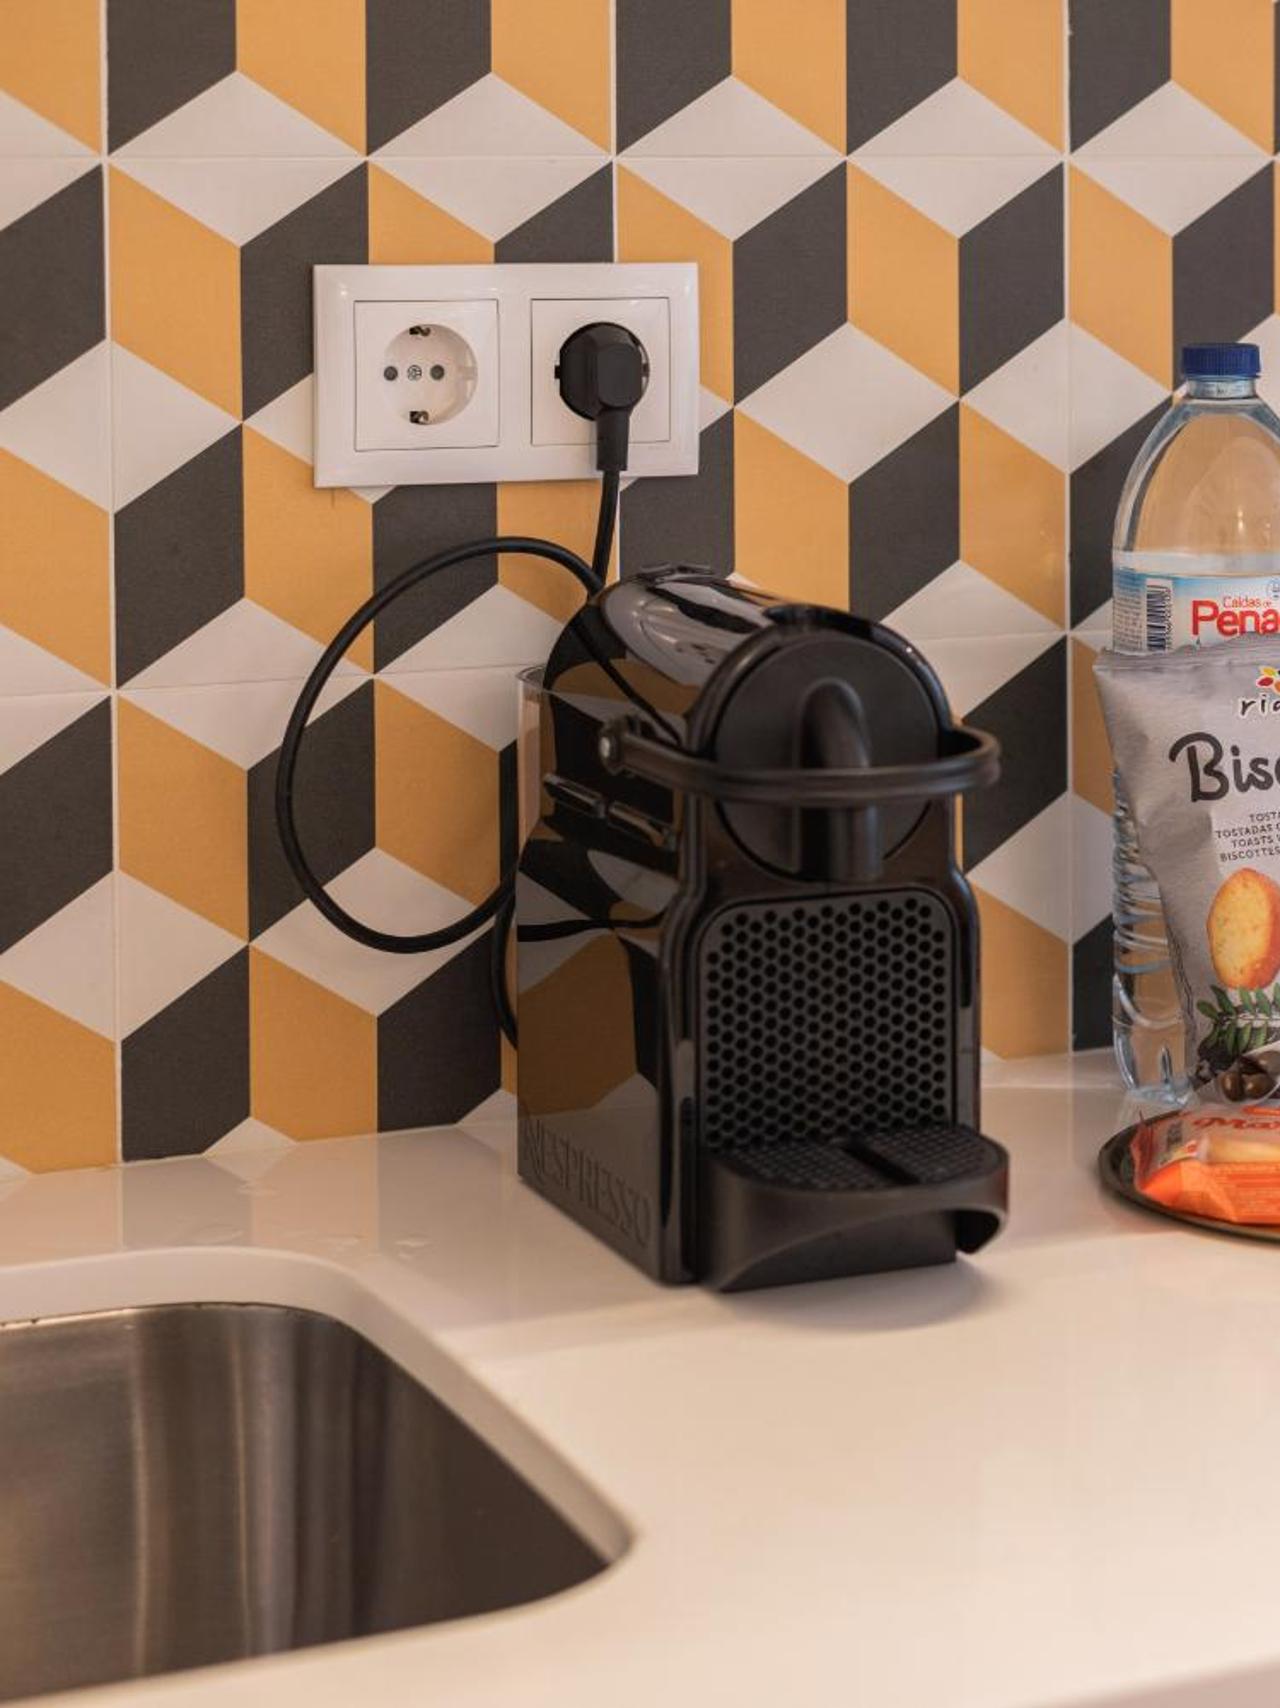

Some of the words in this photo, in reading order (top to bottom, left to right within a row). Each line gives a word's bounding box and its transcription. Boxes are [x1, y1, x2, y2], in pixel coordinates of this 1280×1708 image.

[1223, 595, 1262, 608] Caldas
[1215, 823, 1273, 839] TOSTADAS
[1231, 835, 1274, 849] TOASTS
[523, 1118, 651, 1248] NESPRESSO
